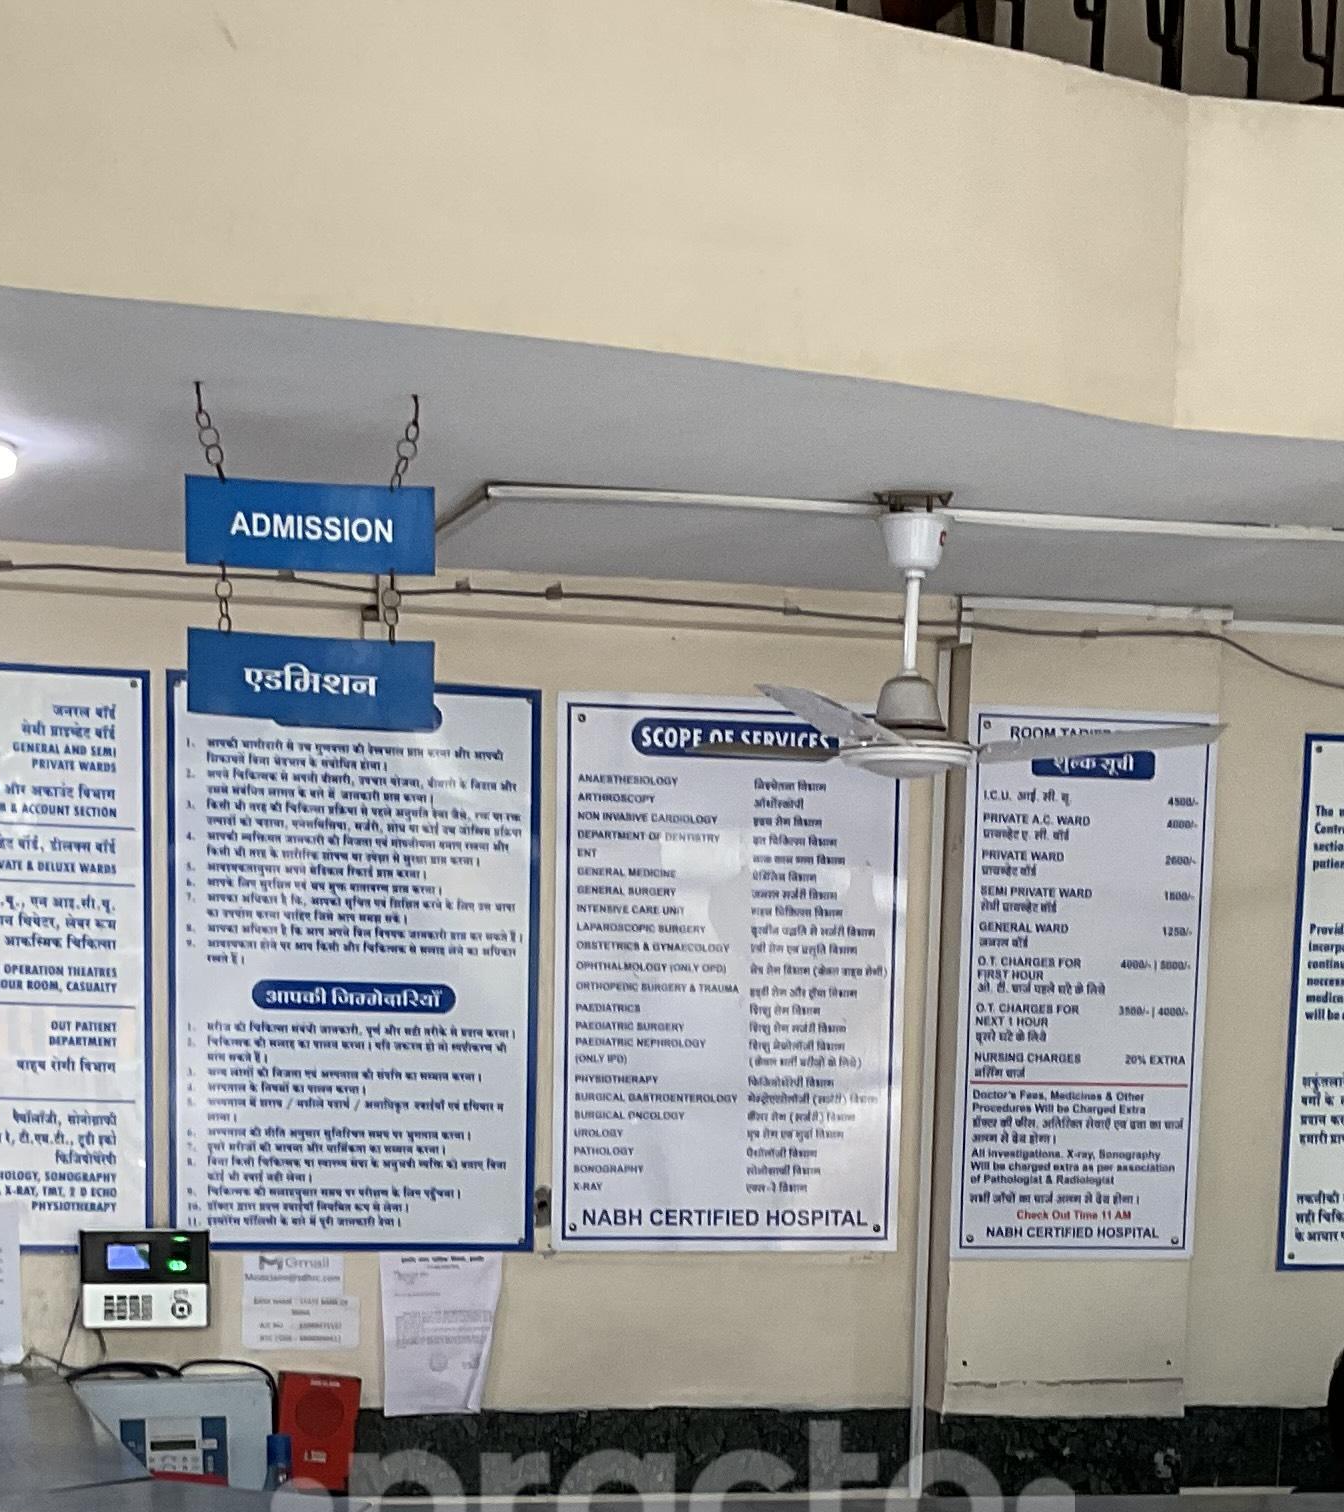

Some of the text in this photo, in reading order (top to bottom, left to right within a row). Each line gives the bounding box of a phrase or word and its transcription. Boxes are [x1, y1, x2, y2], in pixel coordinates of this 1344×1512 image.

[231, 512, 392, 542] ADMISSION
[245, 663, 377, 696] एडमिशन
[53, 705, 90, 718] जनरल
[641, 726, 701, 748] SCOPE
[13, 742, 116, 757] GENERAL AND SEMI
[32, 759, 116, 773] PRIVATE WARDS
[578, 774, 678, 786] ANAESTHESIOLOGY
[578, 792, 655, 803] ARTHROSCOPY
[984, 790, 1009, 800] I.C.U.
[11, 803, 17, 813] &
[22, 804, 70, 816] ACCOUNT
[74, 806, 116, 817] SECTION
[1316, 805, 1333, 816] The
[578, 811, 717, 824] NON INVASIVE CARDIOLOGY
[983, 812, 1090, 826] PRIVATE A.C. WARD
[578, 830, 720, 843] DEPARTMENT OF DENTISTRY
[577, 848, 596, 857] ENT
[982, 849, 1064, 861] PRIVATE WARD
[27, 861, 33, 871] &
[38, 861, 75, 872] DELUXE
[79, 863, 116, 874] WARDS
[577, 867, 675, 878] GENERAL MEDICINE
[577, 885, 676, 896] GENERAL SURGERY
[981, 885, 1092, 898] SEMI PRIVATE WARD
[577, 922, 705, 934] LAPAROSCOPIC SURGERY
[979, 922, 1068, 933] GENERAL WARD
[4, 964, 64, 976] OPERATION
[68, 966, 117, 977] THEATRES
[27, 980, 62, 992] ROOM,
[66, 981, 117, 993] CASUALTY
[266, 988, 326, 1004] आपकी
[51, 1021, 116, 1032] OUT PATIENT
[49, 1036, 116, 1047] DEPARTMENT
[975, 1052, 1081, 1064] NURSING CHARGES
[1150, 1055, 1185, 1065] EXTRA
[45, 1171, 116, 1182] SONOGRAPHY
[5, 1185, 38, 1197] X-RAY,
[80, 1187, 87, 1197] D
[91, 1187, 117, 1198] ECHO
[32, 1201, 116, 1212] PHYSIOTHERAPY
[583, 1209, 868, 1226] NABH CERTIFIED HOSPITAL
[1017, 1210, 1131, 1220] Check Out Time 11 AM
[987, 1227, 1159, 1238] NABH CERTIFIED HOSPITAL
